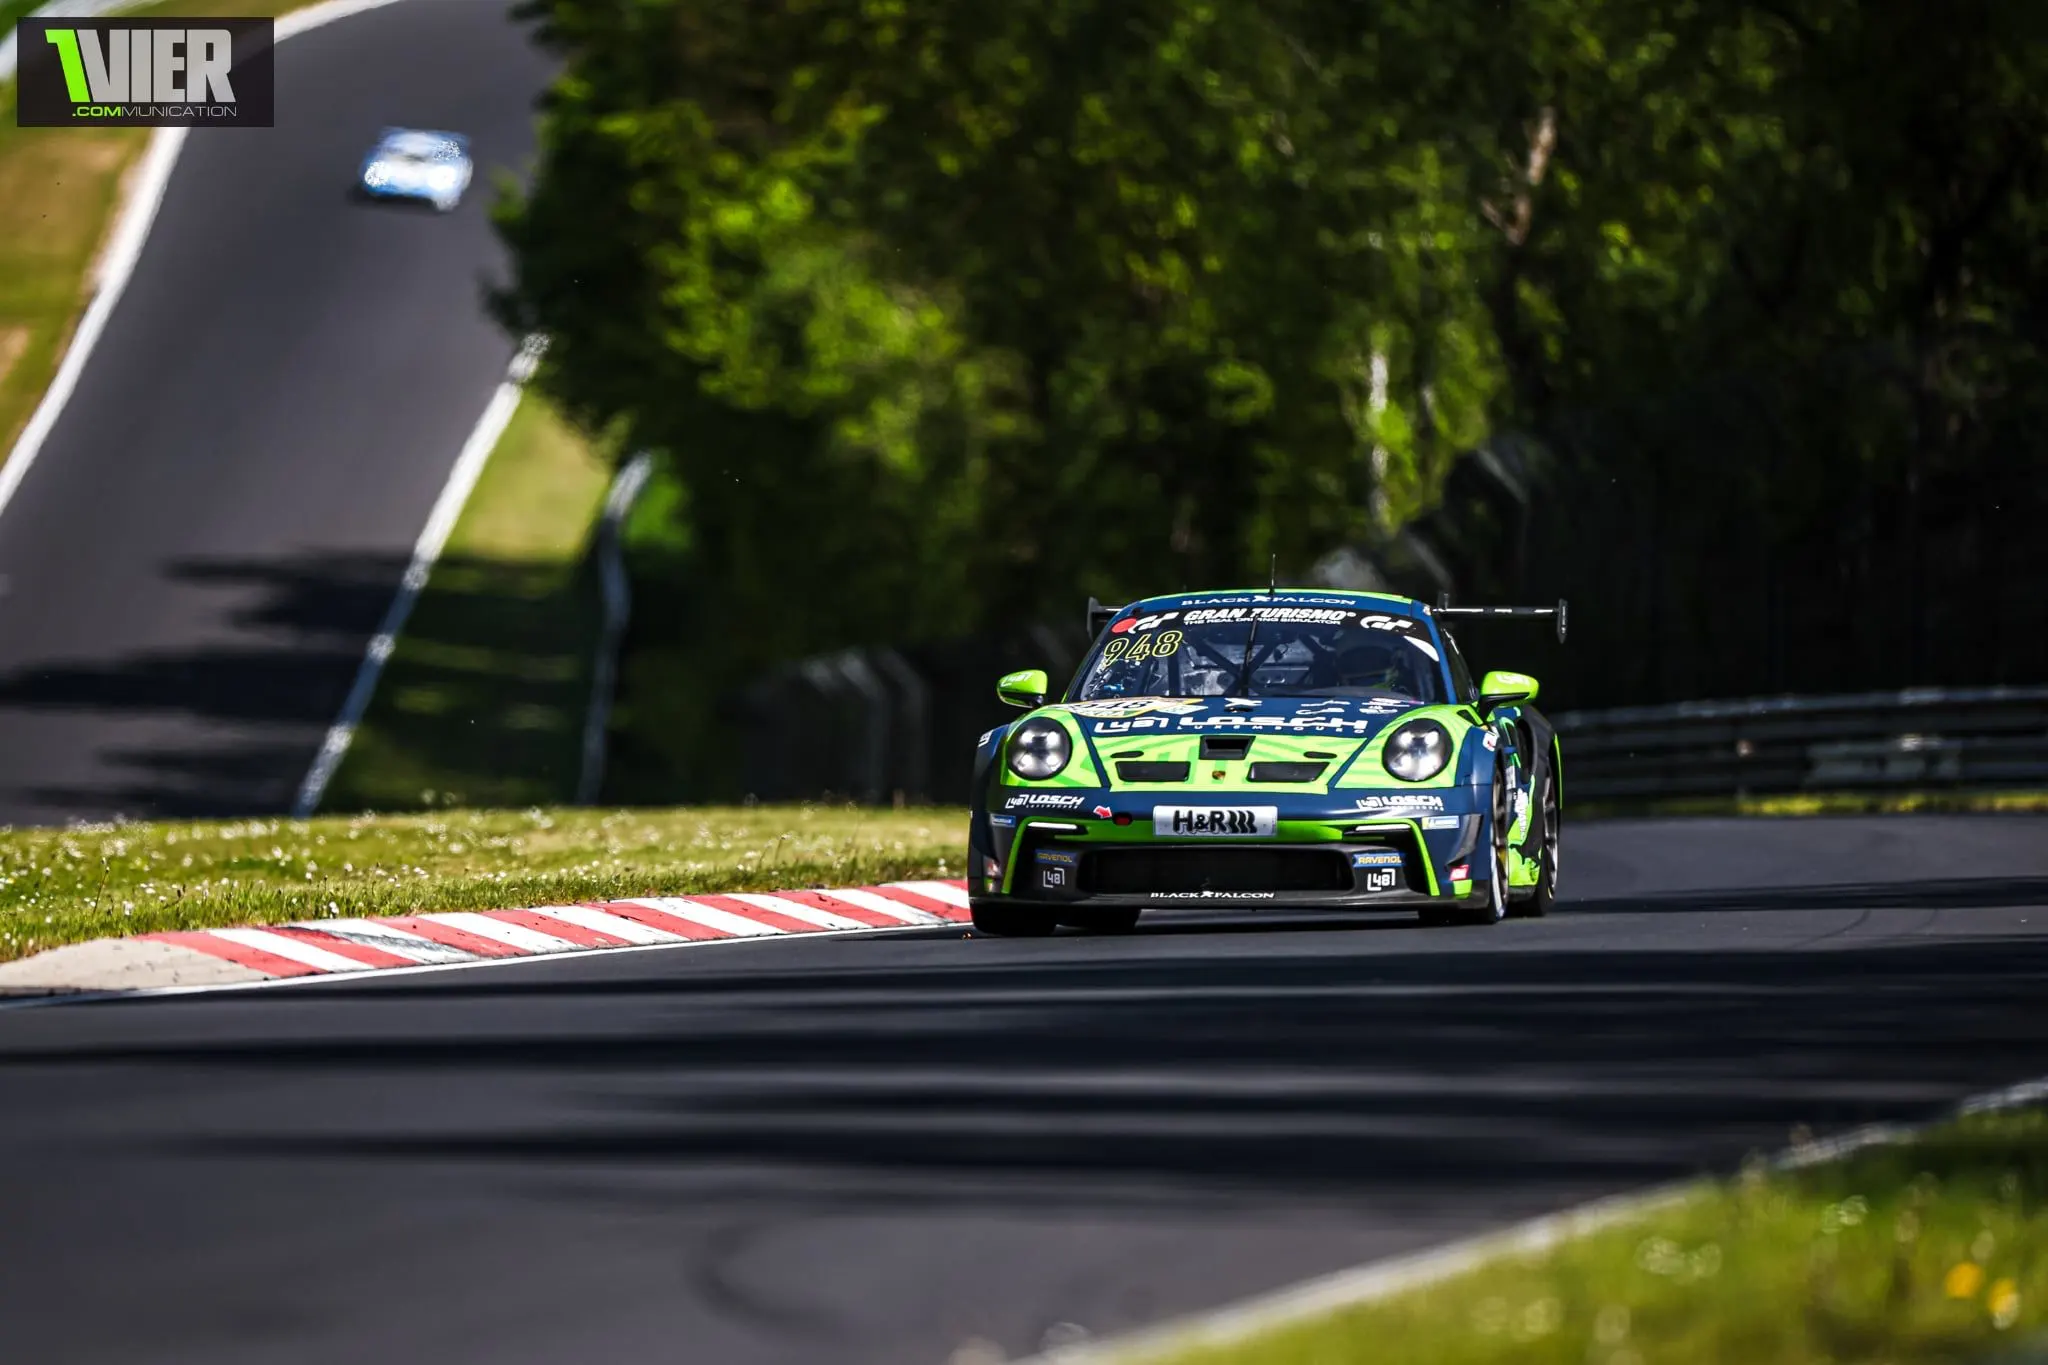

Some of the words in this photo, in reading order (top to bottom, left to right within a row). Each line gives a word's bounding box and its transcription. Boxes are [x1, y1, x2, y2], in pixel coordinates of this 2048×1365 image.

[1181, 597, 1251, 606] BLACK
[1273, 596, 1356, 605] FALCON
[1183, 608, 1247, 621] GRAN
[1279, 618, 1342, 626] SIMULATOR
[1103, 630, 1183, 668] 948
[1179, 715, 1368, 730] LOSCH
[1028, 794, 1085, 806] LOSCH
[1381, 795, 1444, 807] LOSCH
[1172, 810, 1227, 834] H&R
[1357, 855, 1402, 865] RAVENOL
[1215, 891, 1275, 899] FALCON
